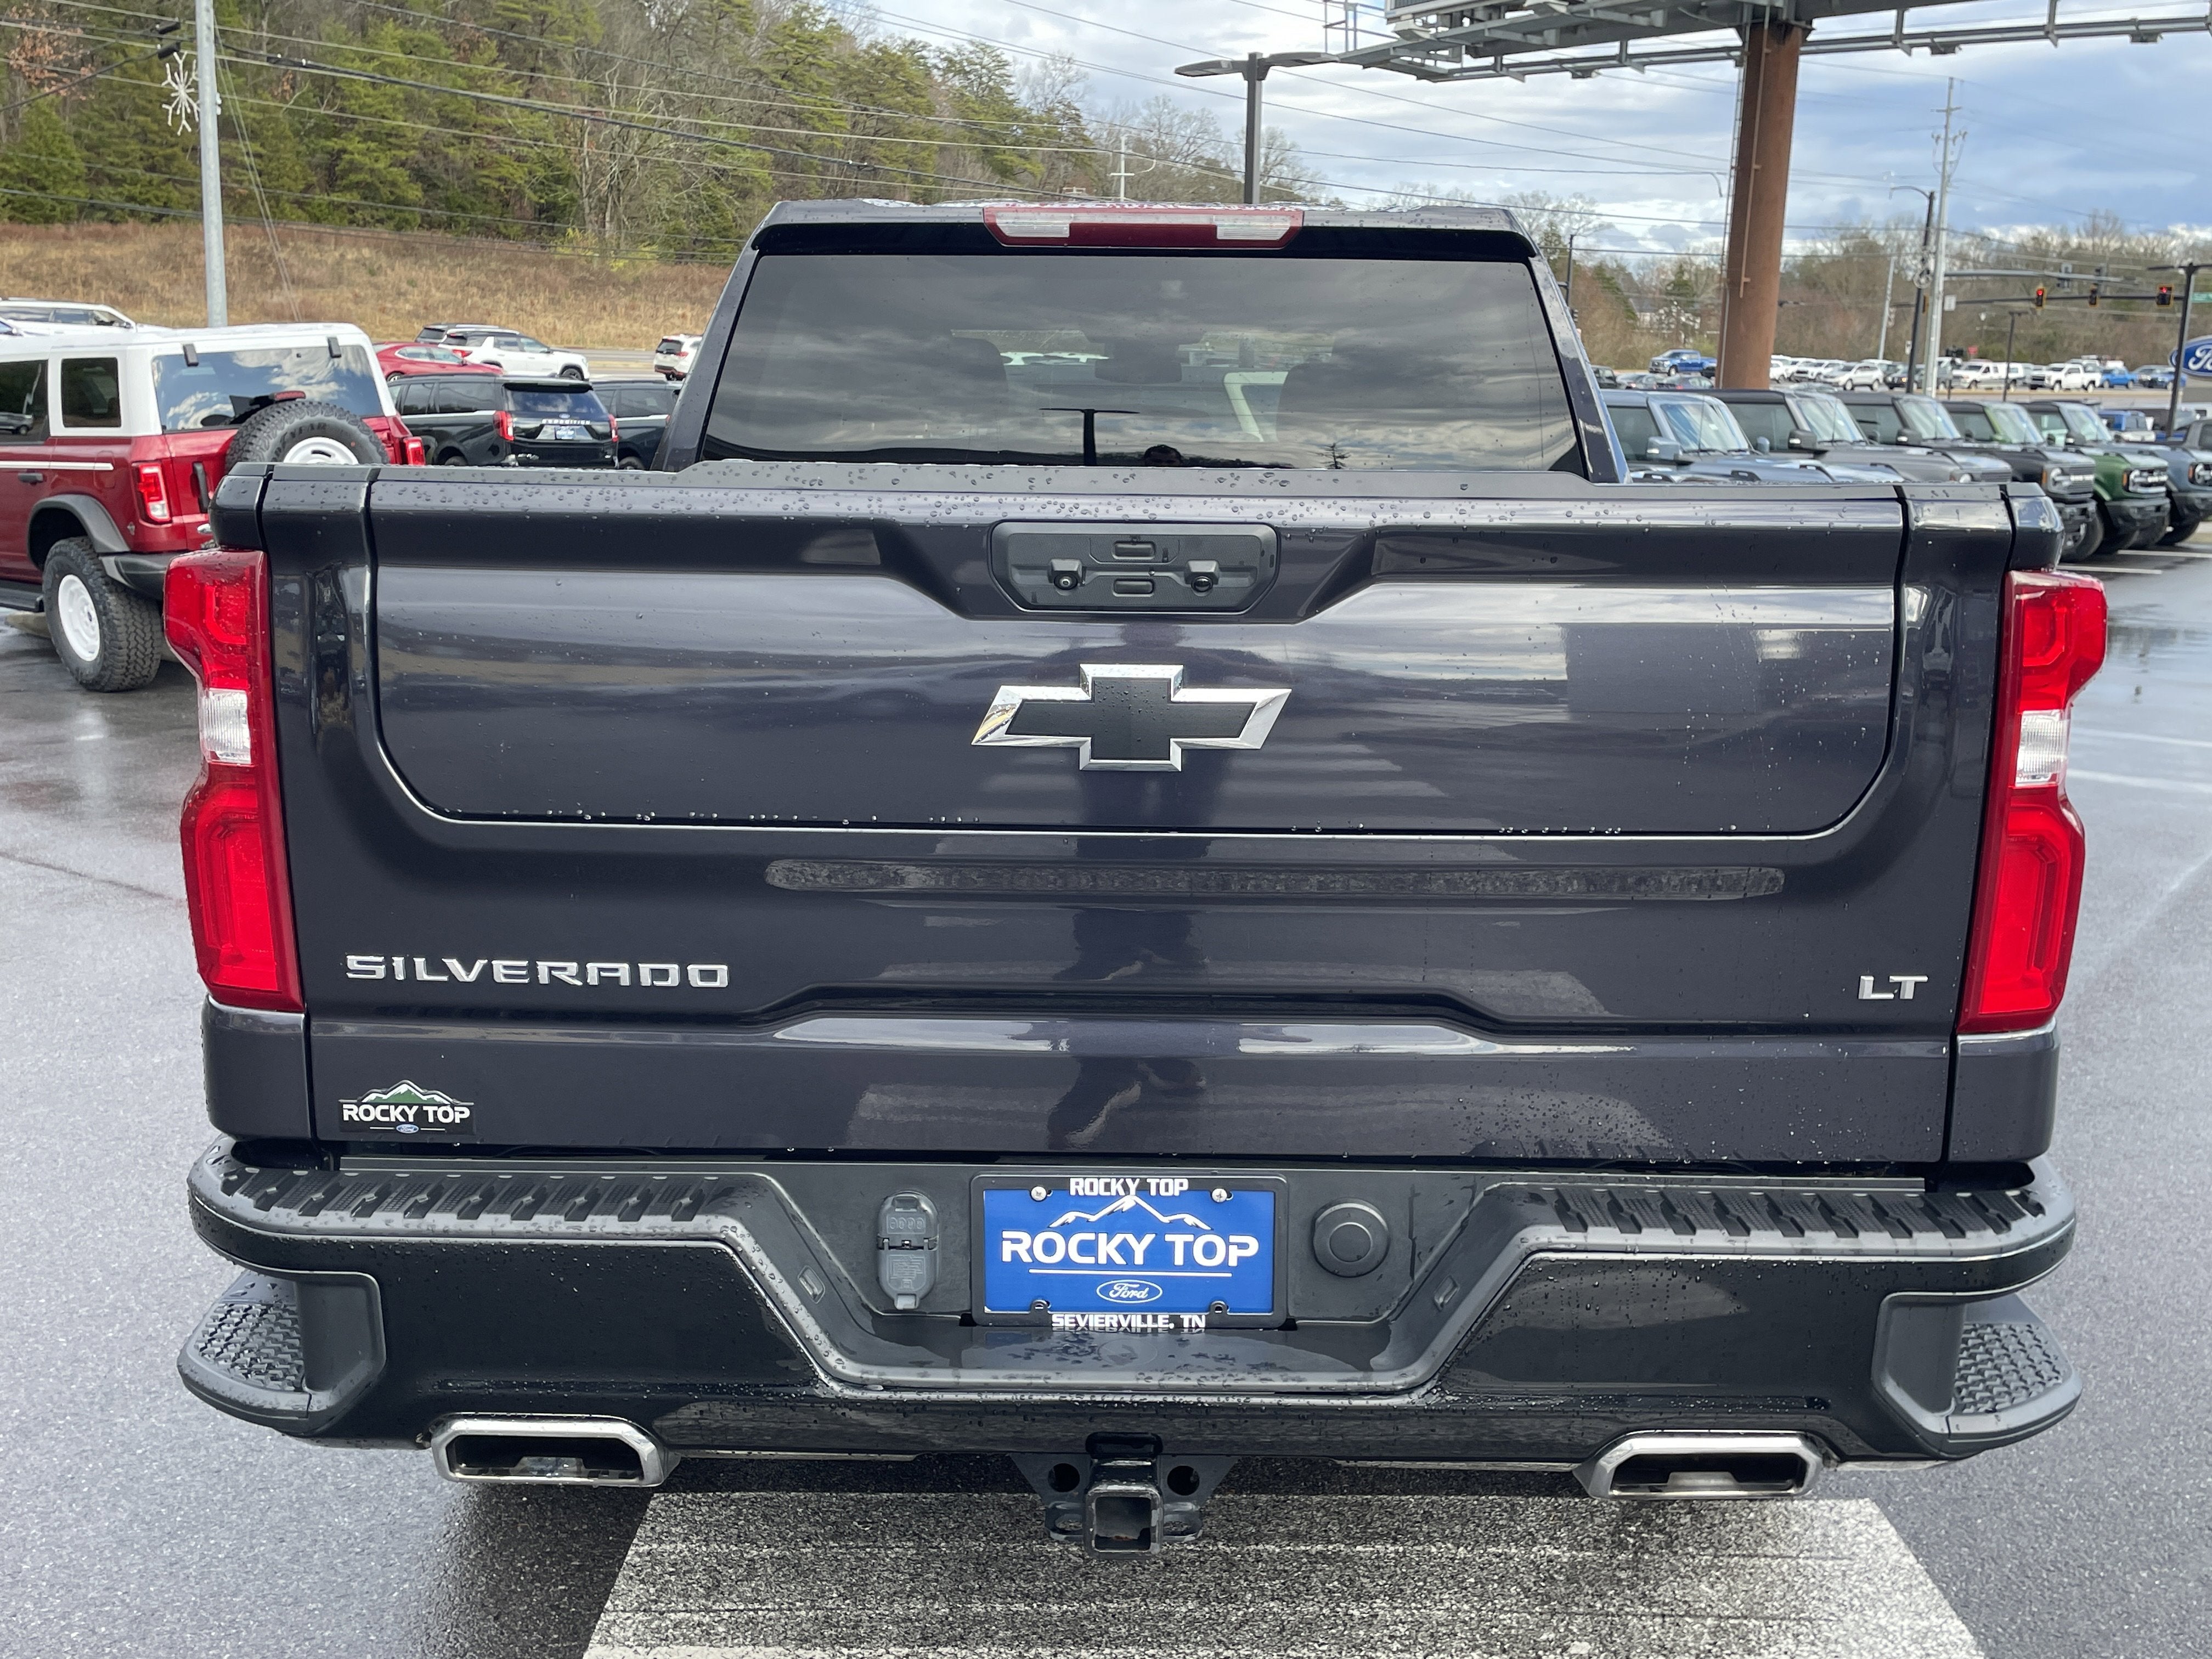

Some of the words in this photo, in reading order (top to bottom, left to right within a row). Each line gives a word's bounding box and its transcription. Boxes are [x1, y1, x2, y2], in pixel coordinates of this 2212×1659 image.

[346, 955, 729, 988] SILVERADO
[1858, 975, 1928, 1000] LT
[342, 1104, 419, 1122] ROCKY
[423, 1105, 470, 1124] TOP
[1070, 1177, 1139, 1196] ROCKY
[1147, 1178, 1188, 1197] TOP
[1002, 1230, 1157, 1265] ROCKY
[1165, 1233, 1260, 1267] TOP
[1108, 1283, 1150, 1300] Ford
[1052, 1313, 1175, 1329] SEVIERVILLE,
[1180, 1314, 1206, 1328] TN
